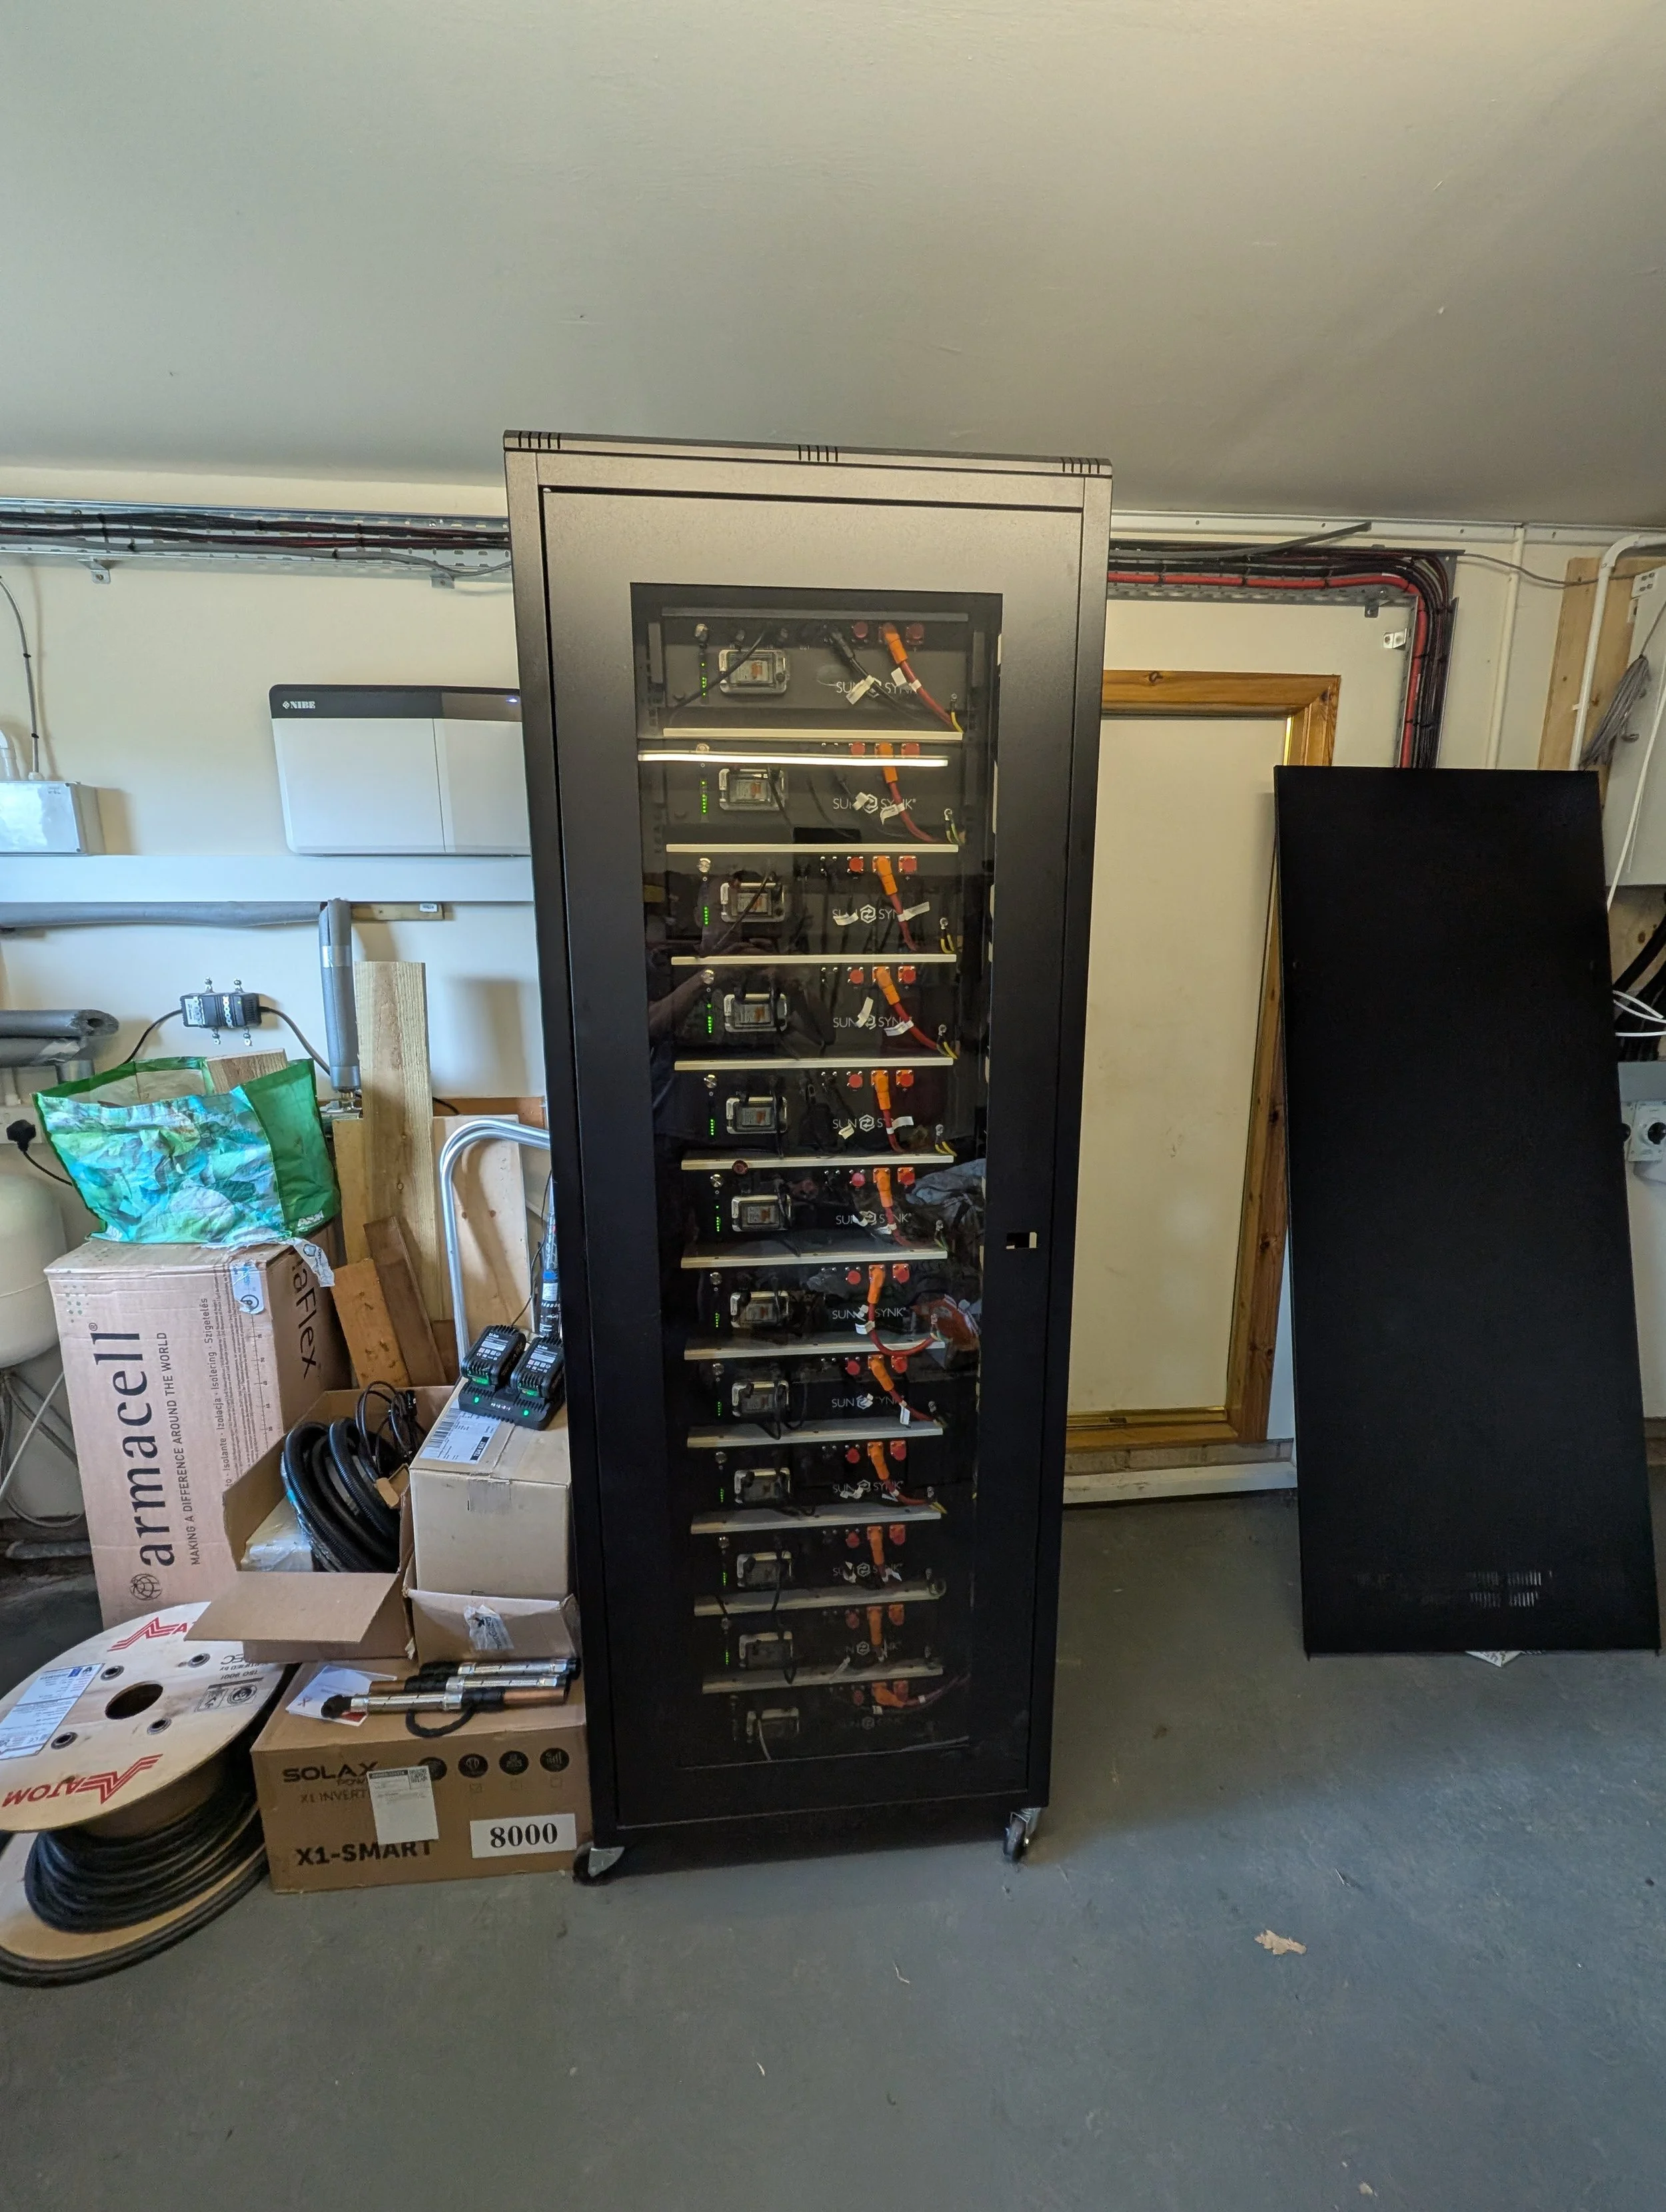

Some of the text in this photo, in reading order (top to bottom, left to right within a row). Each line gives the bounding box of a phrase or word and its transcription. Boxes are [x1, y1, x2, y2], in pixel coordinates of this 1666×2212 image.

[200, 1298, 213, 1344] Szigetelés
[157, 1333, 172, 1372] WORLD
[207, 1351, 219, 1390] Isolering
[163, 1375, 175, 1396] THE
[167, 1400, 183, 1444] AROUND
[213, 1397, 225, 1430] Izolacja
[220, 1437, 231, 1471] Isolante
[173, 1447, 192, 1512] DIFFERENCE
[185, 1526, 201, 1566] MAKING
[283, 1761, 379, 1783] SOLAX
[295, 1840, 433, 1866] X1-SMART
[490, 1822, 558, 1849] 8000
